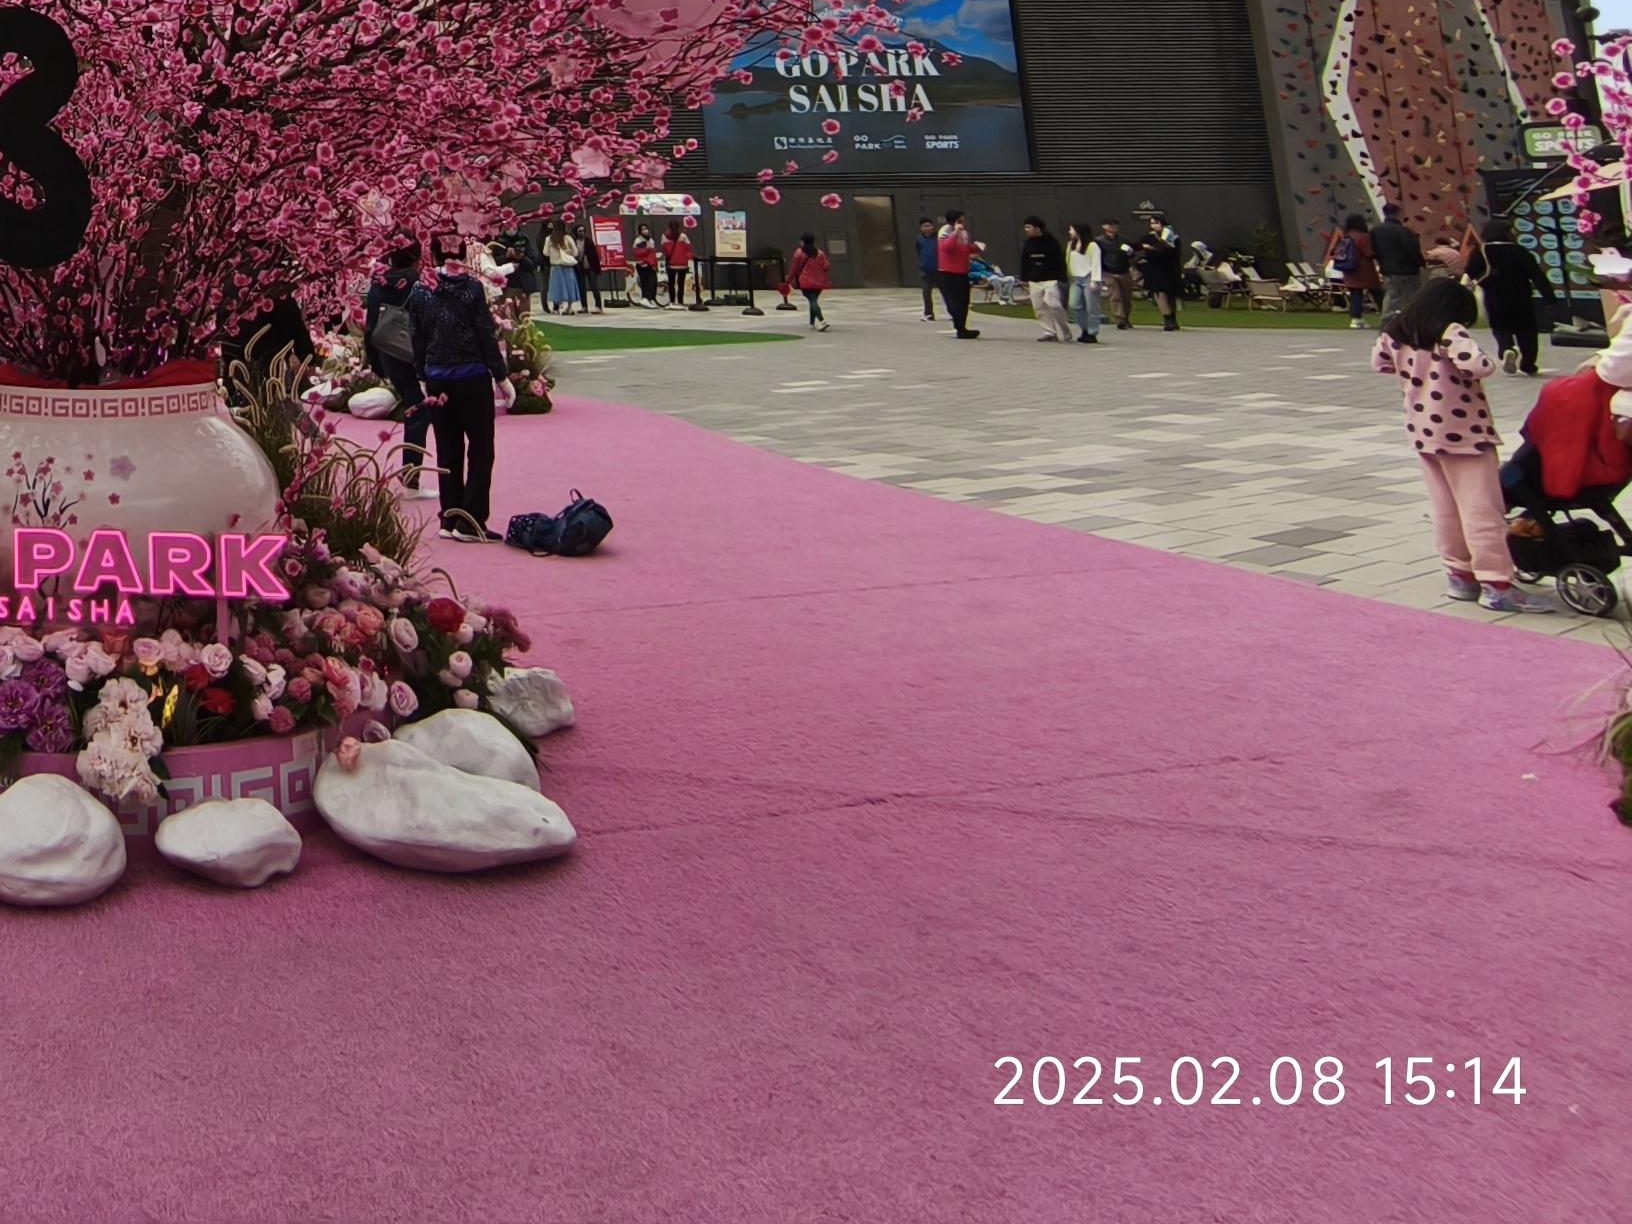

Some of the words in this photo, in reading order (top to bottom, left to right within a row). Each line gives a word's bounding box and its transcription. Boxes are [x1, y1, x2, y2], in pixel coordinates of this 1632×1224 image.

[775, 49, 829, 78] GO
[837, 48, 944, 77] PARK
[789, 84, 850, 114] SAI
[857, 83, 936, 113] SHA
[13, 527, 291, 600] PARK
[67, 598, 136, 625] SHA
